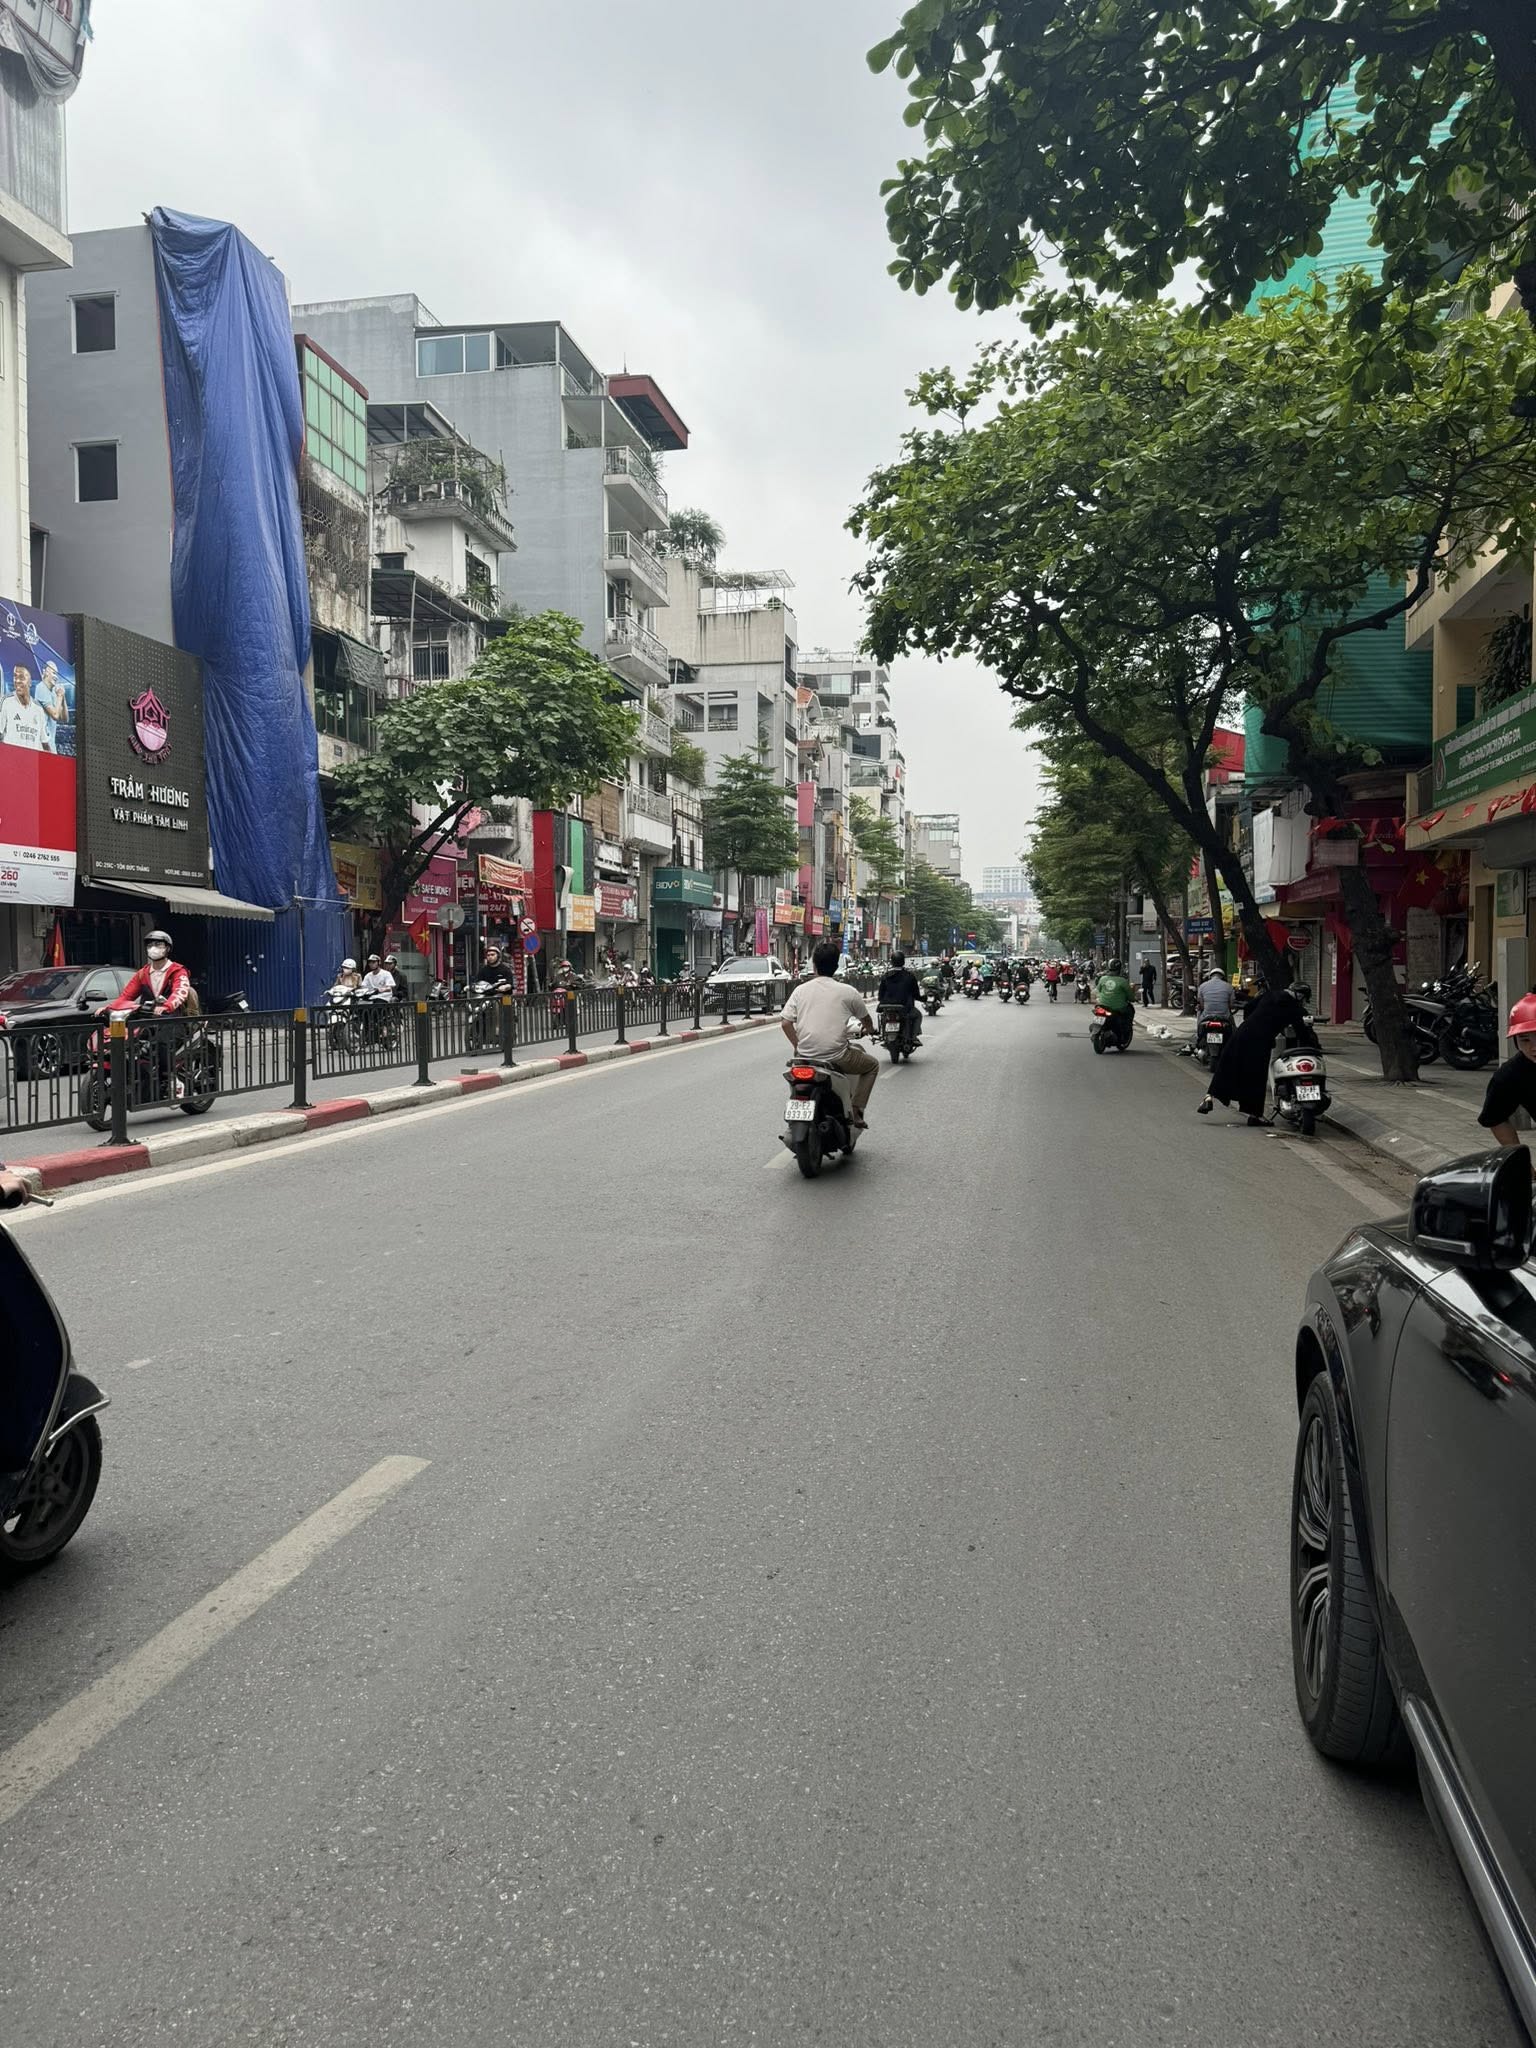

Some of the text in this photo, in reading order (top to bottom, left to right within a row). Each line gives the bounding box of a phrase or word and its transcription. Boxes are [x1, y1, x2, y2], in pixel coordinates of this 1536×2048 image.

[111, 774, 190, 808] TRẦM HƯƠNG
[113, 807, 130, 823] VẬT
